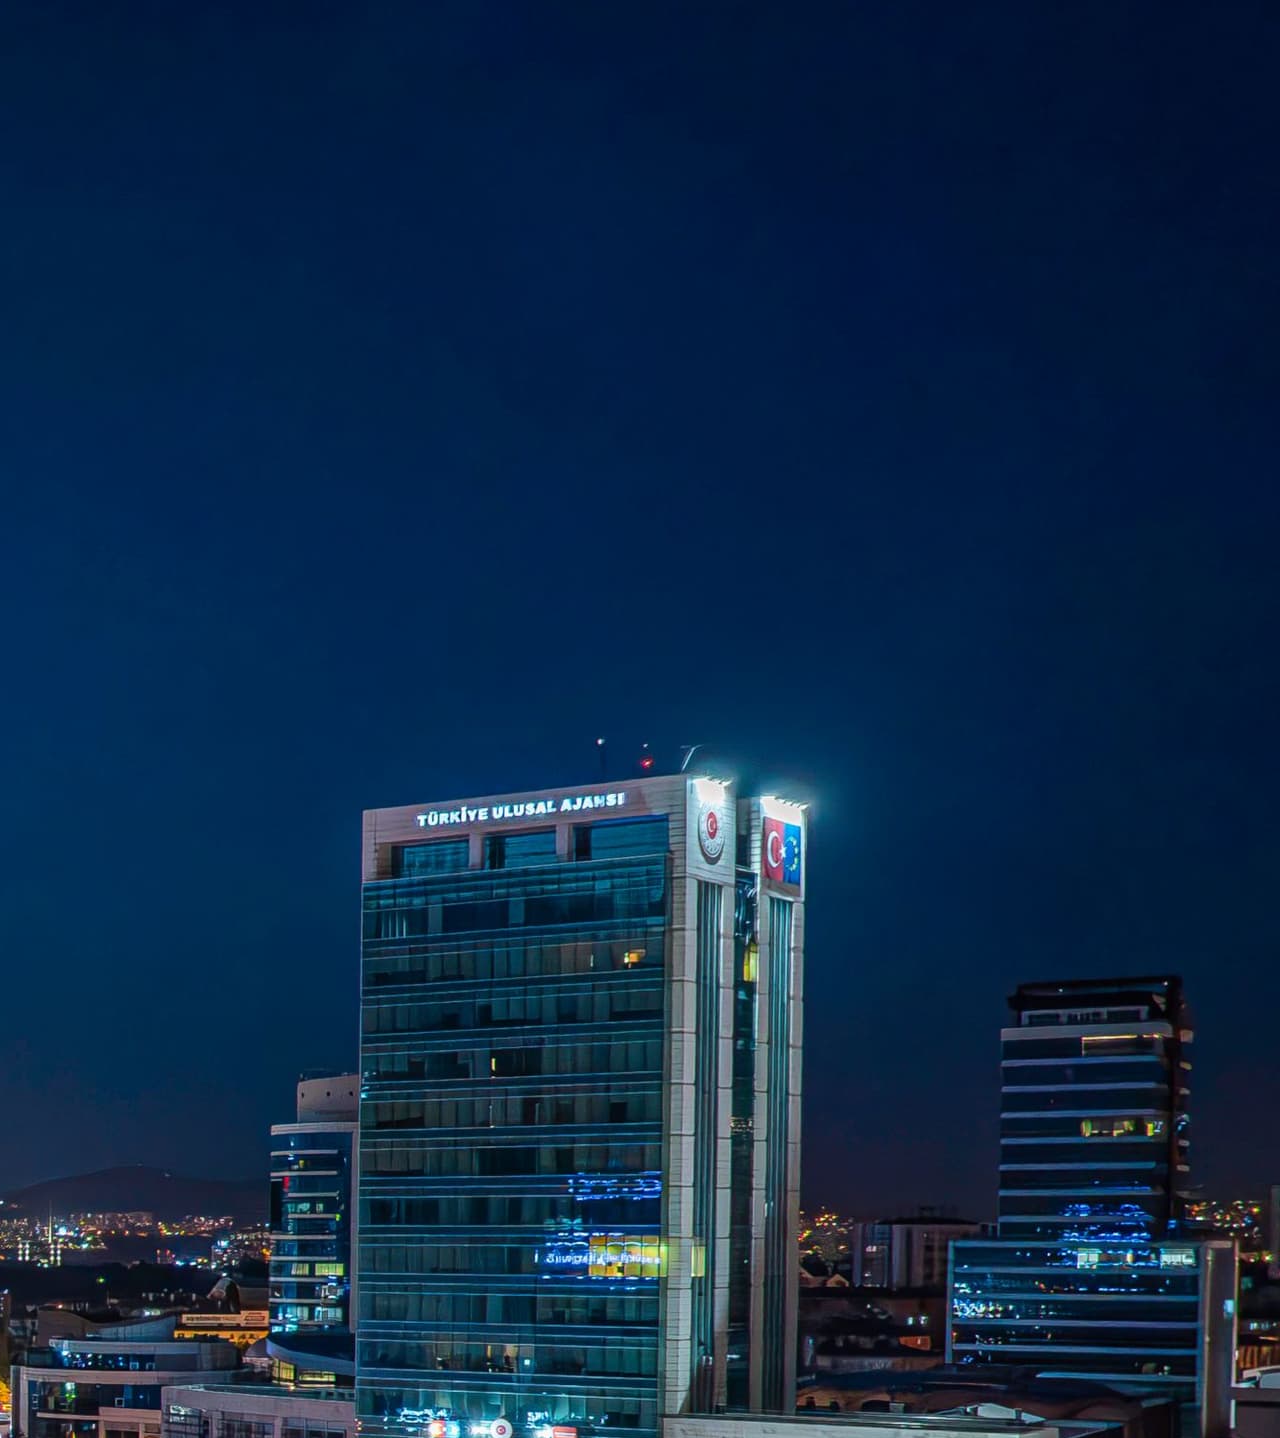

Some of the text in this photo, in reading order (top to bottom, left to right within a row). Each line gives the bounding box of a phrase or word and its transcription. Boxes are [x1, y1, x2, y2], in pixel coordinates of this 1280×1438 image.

[416, 792, 625, 827] TÜRKİYE ULUSAL AJANSI
